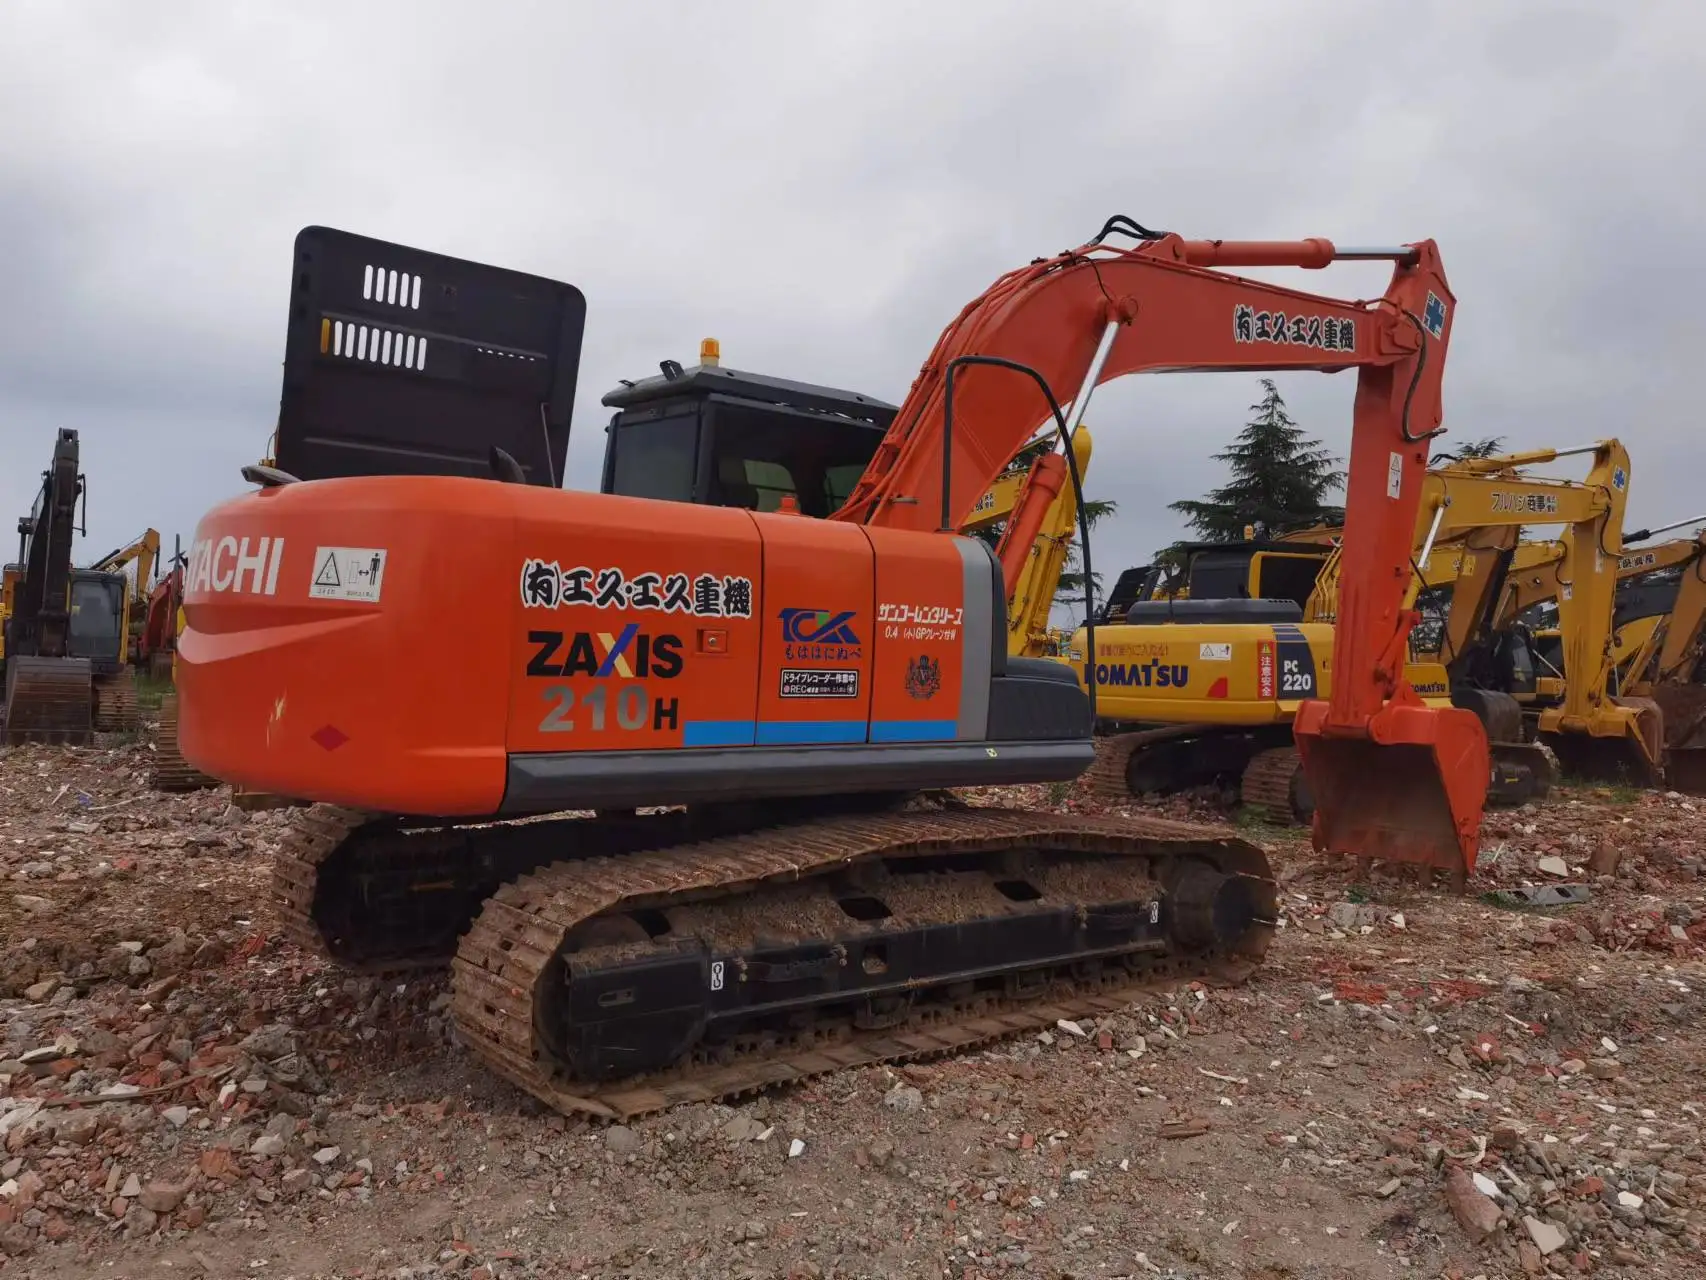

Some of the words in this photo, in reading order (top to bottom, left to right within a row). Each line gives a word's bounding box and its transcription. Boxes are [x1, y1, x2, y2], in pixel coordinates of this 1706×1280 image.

[185, 536, 284, 595] ITACHI
[526, 623, 683, 678] ZAXIS
[1284, 660, 1298, 672] PC
[790, 685, 807, 693] REC
[1283, 674, 1311, 691] 220
[1411, 681, 1446, 693] OMATSU
